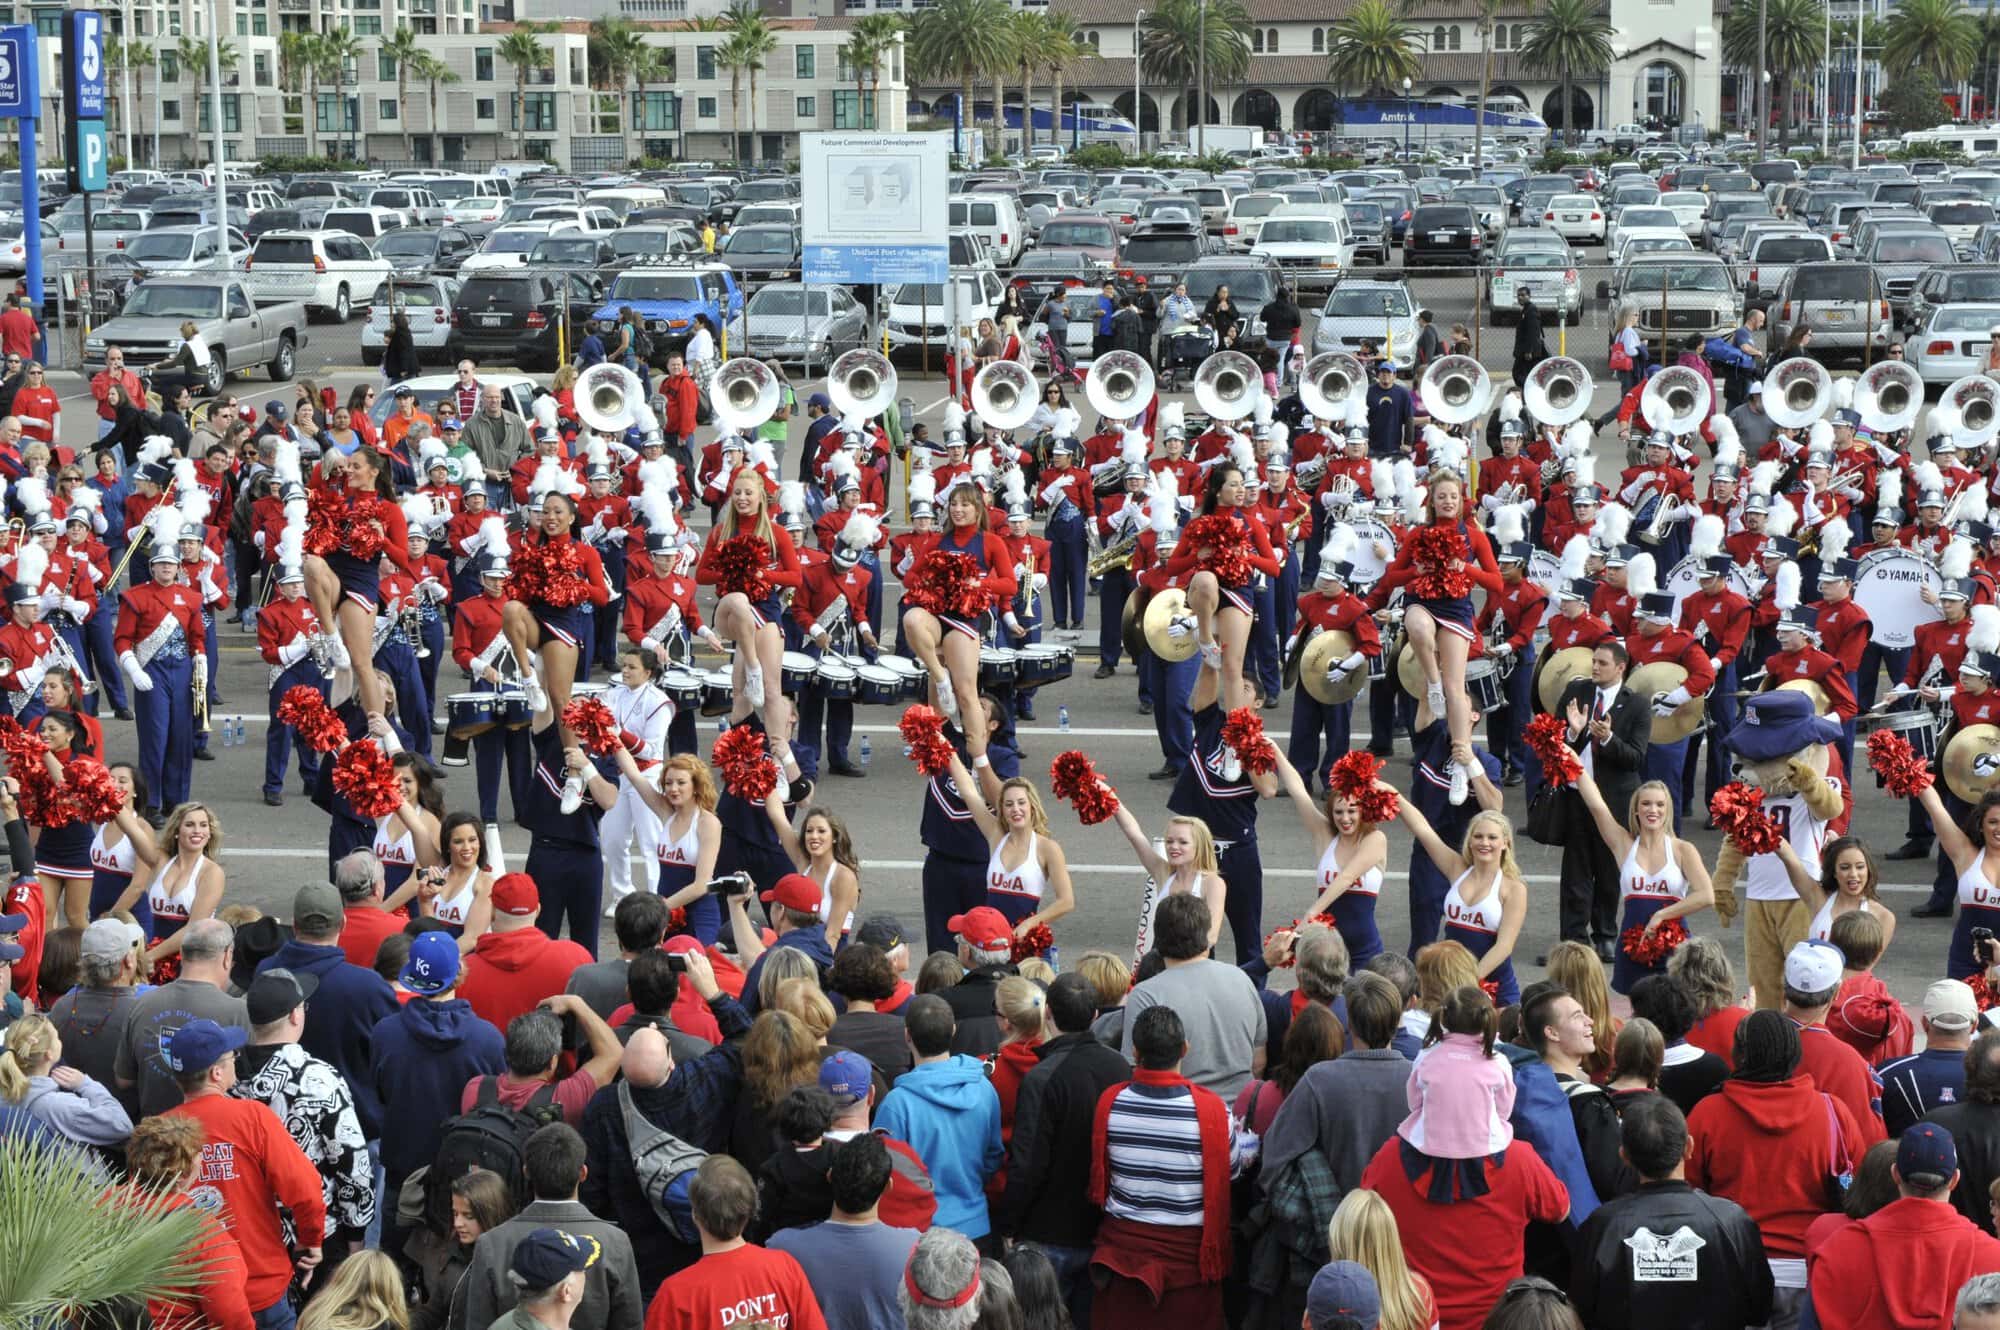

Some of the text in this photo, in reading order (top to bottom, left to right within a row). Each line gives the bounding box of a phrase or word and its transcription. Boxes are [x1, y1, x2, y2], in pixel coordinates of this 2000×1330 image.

[821, 138, 928, 148] Future Commercial Development
[86, 133, 102, 179] P
[880, 247, 897, 257] Port
[1889, 569, 1930, 584] YAMAHA
[415, 957, 430, 976] KC
[199, 1161, 235, 1182] LIFE
[720, 1293, 776, 1327] DON'T
